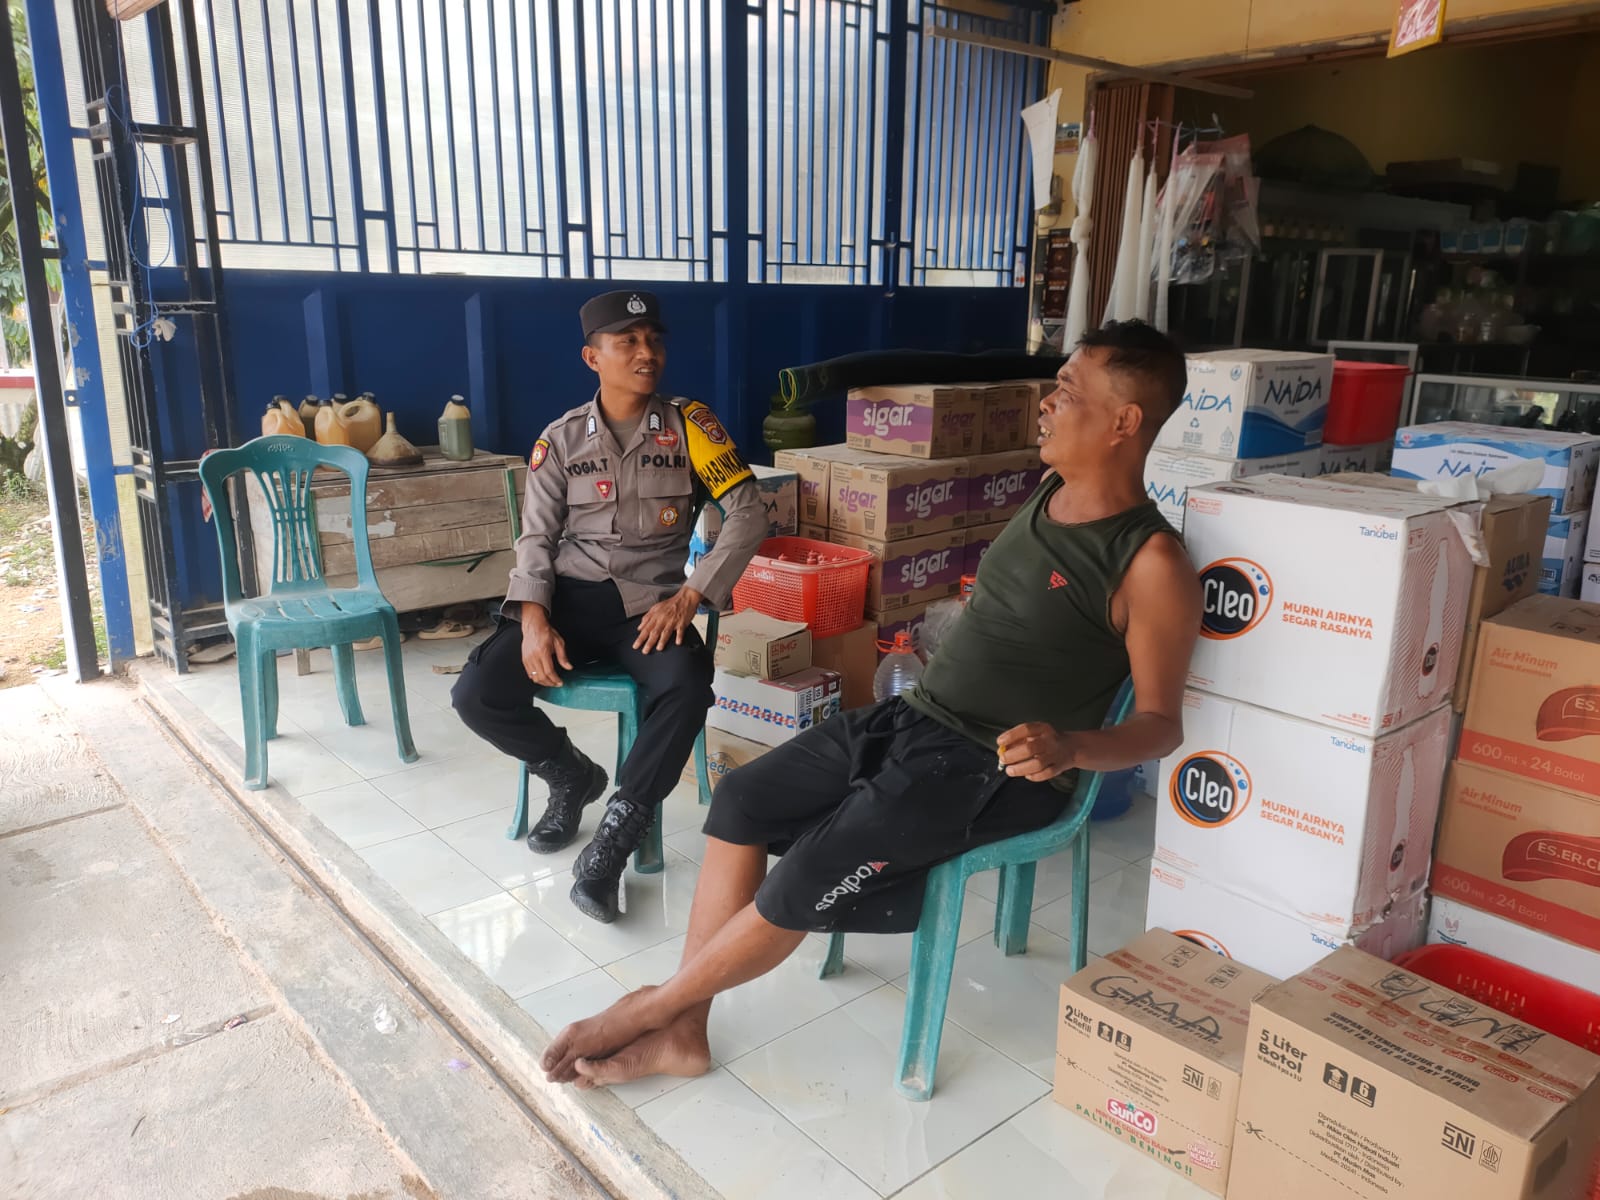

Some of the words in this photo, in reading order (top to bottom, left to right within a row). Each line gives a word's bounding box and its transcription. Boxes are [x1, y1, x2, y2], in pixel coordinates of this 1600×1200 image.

[641, 454, 687, 468] POLRI
[1203, 578, 1254, 622] Cleo
[1283, 601, 1324, 619] MURNI
[1326, 609, 1373, 629] AIRNYA
[1282, 613, 1318, 630] SEGAR
[1320, 620, 1373, 640] RASANYA
[1515, 651, 1558, 670] Minum
[1472, 742, 1502, 760] 600
[1530, 757, 1552, 773] 24
[1554, 766, 1585, 783] Botol
[1185, 767, 1233, 813] Cleo
[1481, 791, 1522, 814] Minum
[1260, 809, 1294, 829] SEGAR
[1296, 822, 1344, 846] RASANYA
[1261, 798, 1300, 819] MURNI
[1302, 811, 1345, 835] AIRNYA
[815, 865, 872, 911] adidas
[1065, 1004, 1073, 1022] 2
[1074, 1007, 1093, 1025] Liter
[1072, 1017, 1092, 1034] Refill
[1258, 1042, 1302, 1074] Botol
[1260, 1029, 1270, 1042] 5
[1273, 1034, 1308, 1061] Liter
[1183, 1066, 1204, 1090] SNI
[1393, 1053, 1417, 1067] AND
[1416, 1064, 1443, 1078] DRY
[1440, 1075, 1478, 1094] PLACE
[1358, 1082, 1370, 1098] 6
[1075, 1103, 1123, 1136] PALING
[1109, 1100, 1153, 1131] SunCo
[1441, 1125, 1475, 1157] SNI
